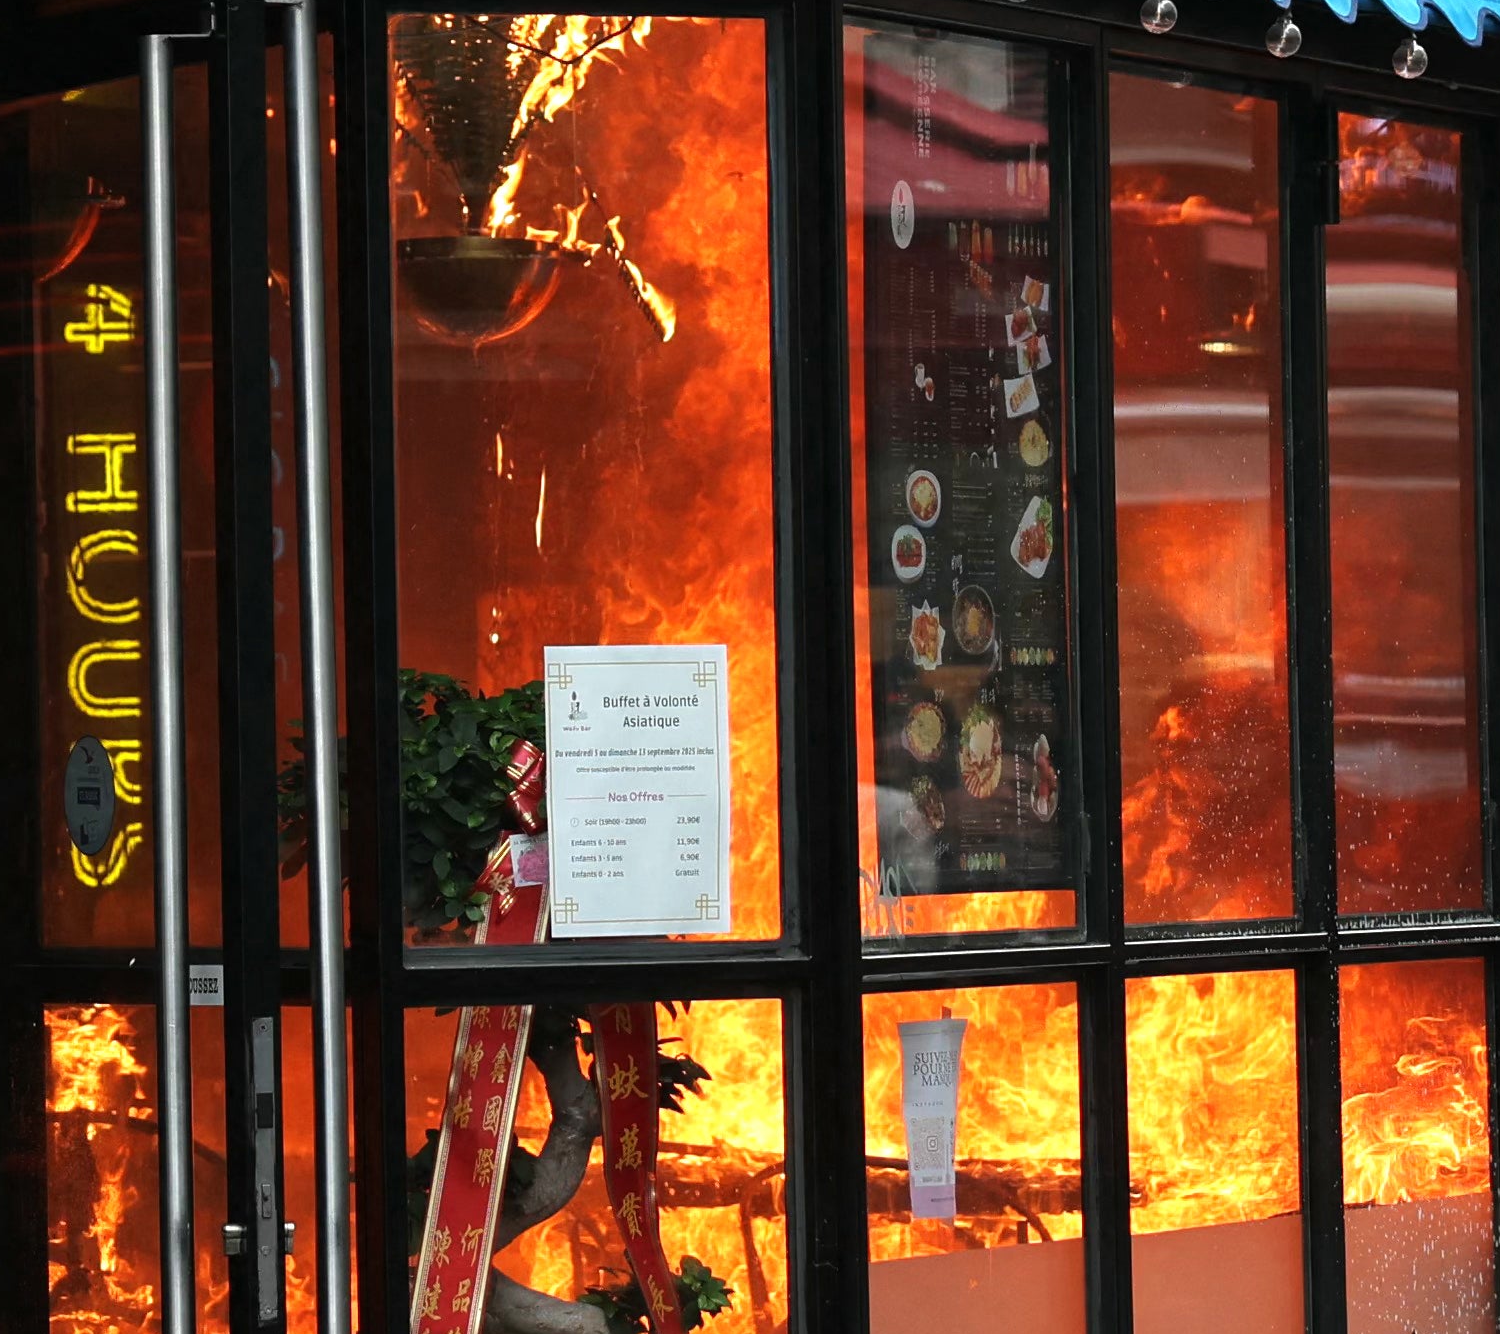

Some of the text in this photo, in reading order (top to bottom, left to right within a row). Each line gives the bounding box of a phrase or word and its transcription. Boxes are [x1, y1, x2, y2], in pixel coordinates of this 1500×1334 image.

[603, 694, 699, 708] Buffet à Volonté
[623, 715, 680, 729] Asiatique
[565, 748, 593, 757] vendredi
[608, 747, 637, 756] dimanche
[647, 748, 679, 757] septembre
[609, 792, 664, 802] Nos Offres
